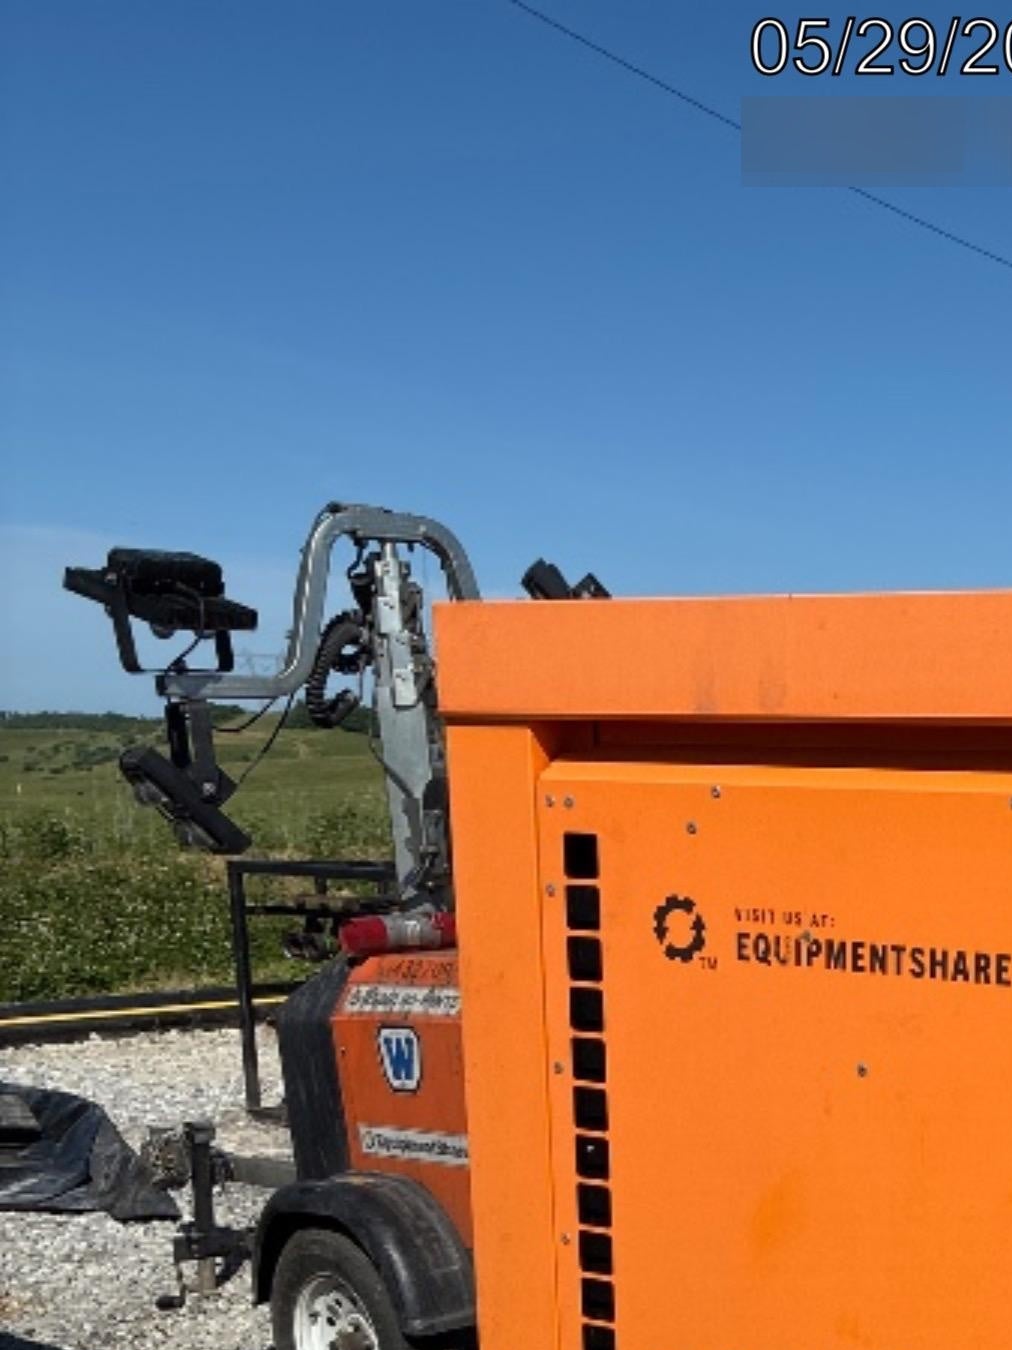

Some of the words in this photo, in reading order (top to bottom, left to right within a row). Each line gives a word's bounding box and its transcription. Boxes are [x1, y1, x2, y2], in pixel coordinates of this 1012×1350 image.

[734, 907, 777, 925] VISIT
[782, 911, 803, 927] US
[809, 914, 836, 928] AT:
